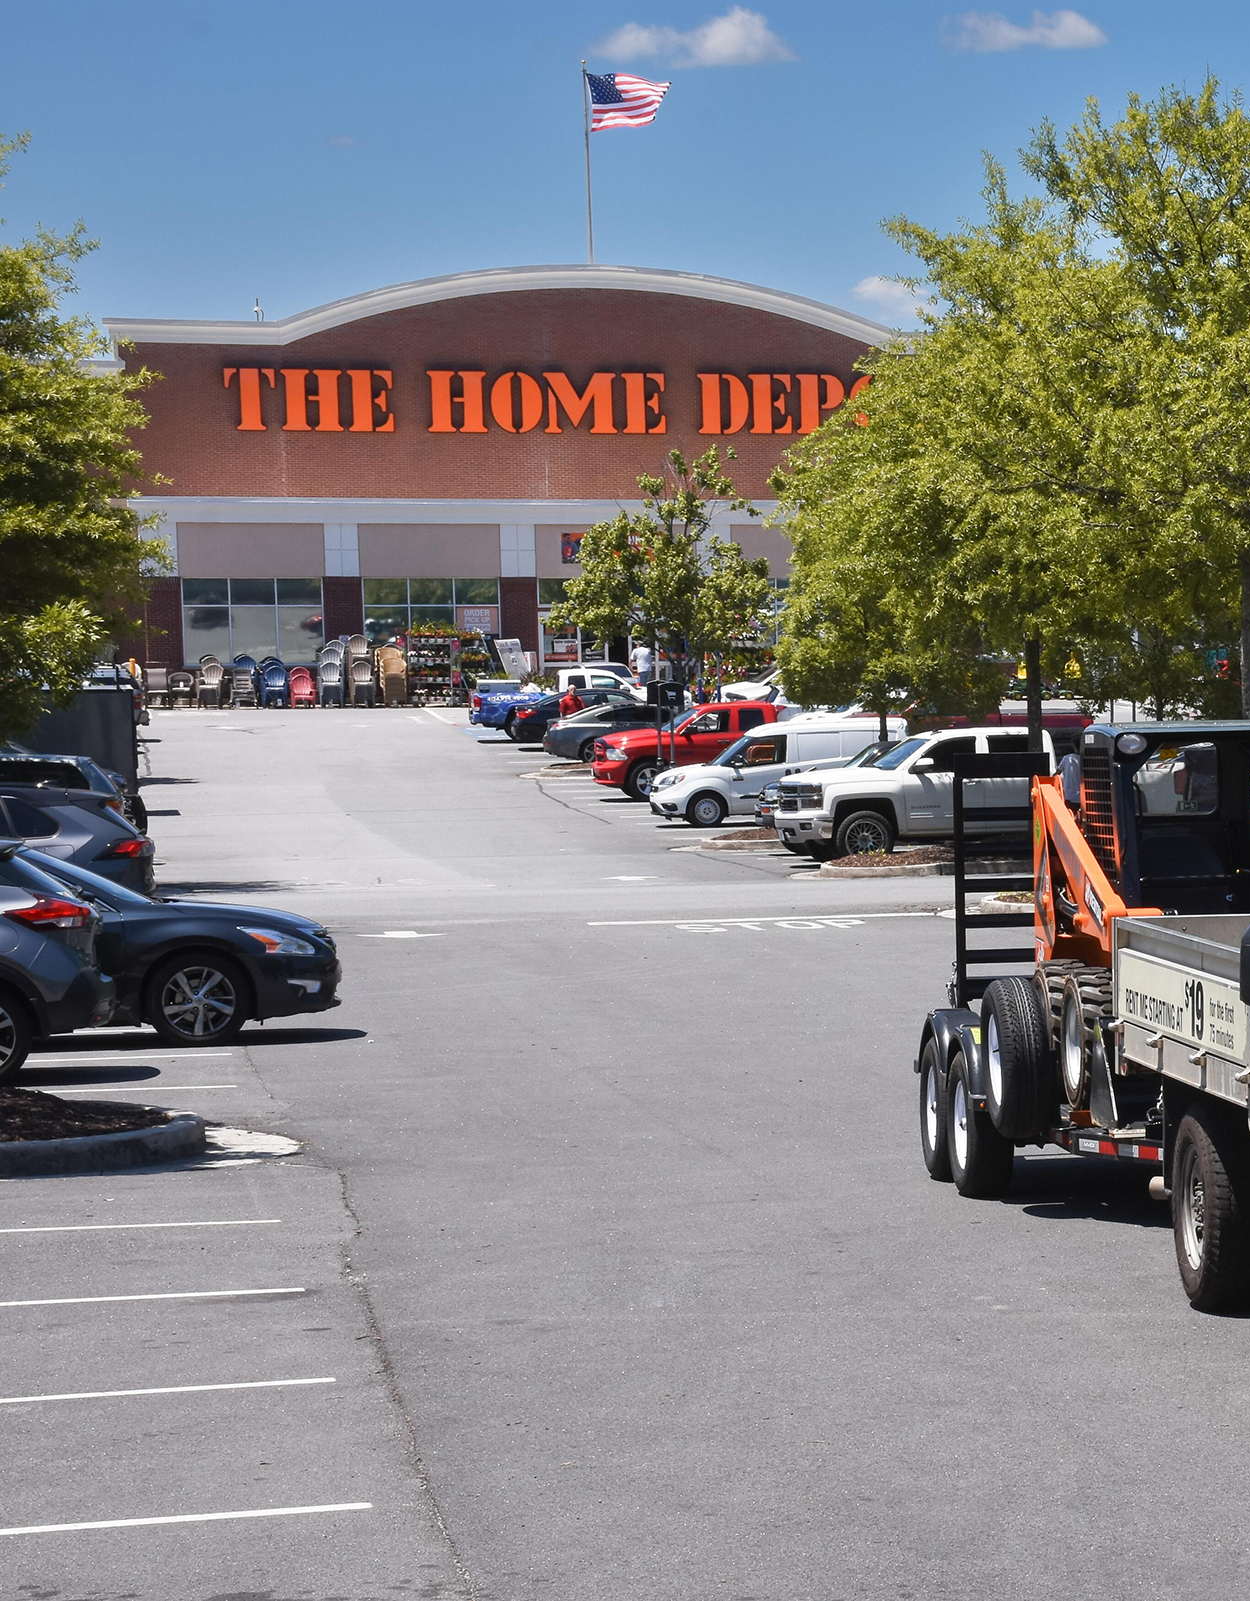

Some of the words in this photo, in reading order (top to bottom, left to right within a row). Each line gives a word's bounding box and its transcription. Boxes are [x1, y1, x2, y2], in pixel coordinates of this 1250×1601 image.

[222, 367, 395, 432] THE
[425, 370, 667, 435] HOME
[463, 608, 490, 617] ORDER
[675, 919, 866, 933] STOP
[1125, 988, 1139, 1016] RENT
[1139, 992, 1148, 1020] ME
[1148, 996, 1176, 1030] STARTING
[1175, 1005, 1184, 1032] AT
[1184, 978, 1205, 1041] $19
[1209, 997, 1217, 1018] for
[1216, 1000, 1224, 1021] the
[1224, 1002, 1235, 1024] first
[1209, 1023, 1216, 1043] 75
[1216, 1027, 1235, 1050] minutes
